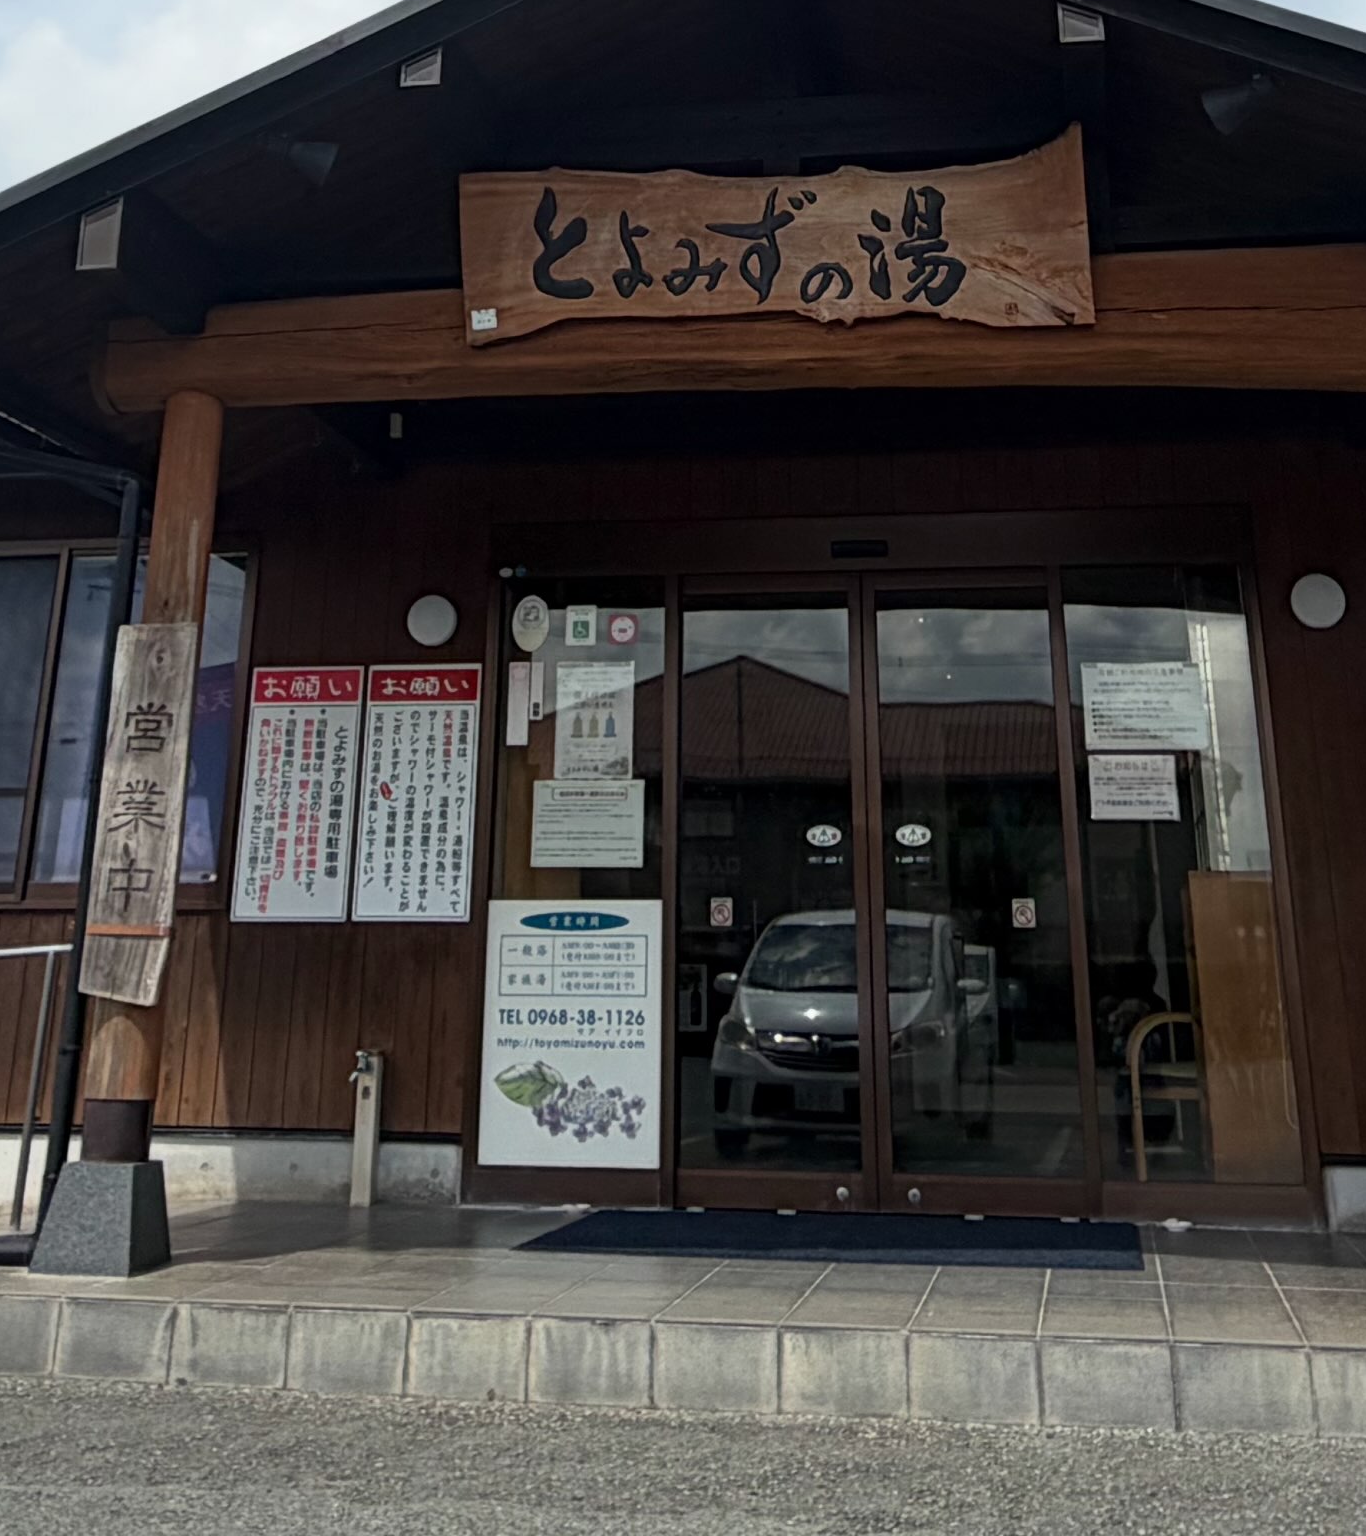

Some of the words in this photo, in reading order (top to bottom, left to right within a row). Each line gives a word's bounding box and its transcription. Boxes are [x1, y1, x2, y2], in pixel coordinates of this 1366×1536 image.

[533, 186, 966, 306] とよみずの湯
[262, 675, 352, 700] お願い
[381, 675, 469, 697] お願い
[106, 702, 173, 912] 営業中
[499, 1008, 523, 1025] TEL
[528, 1009, 645, 1026] 0968-38-1126
